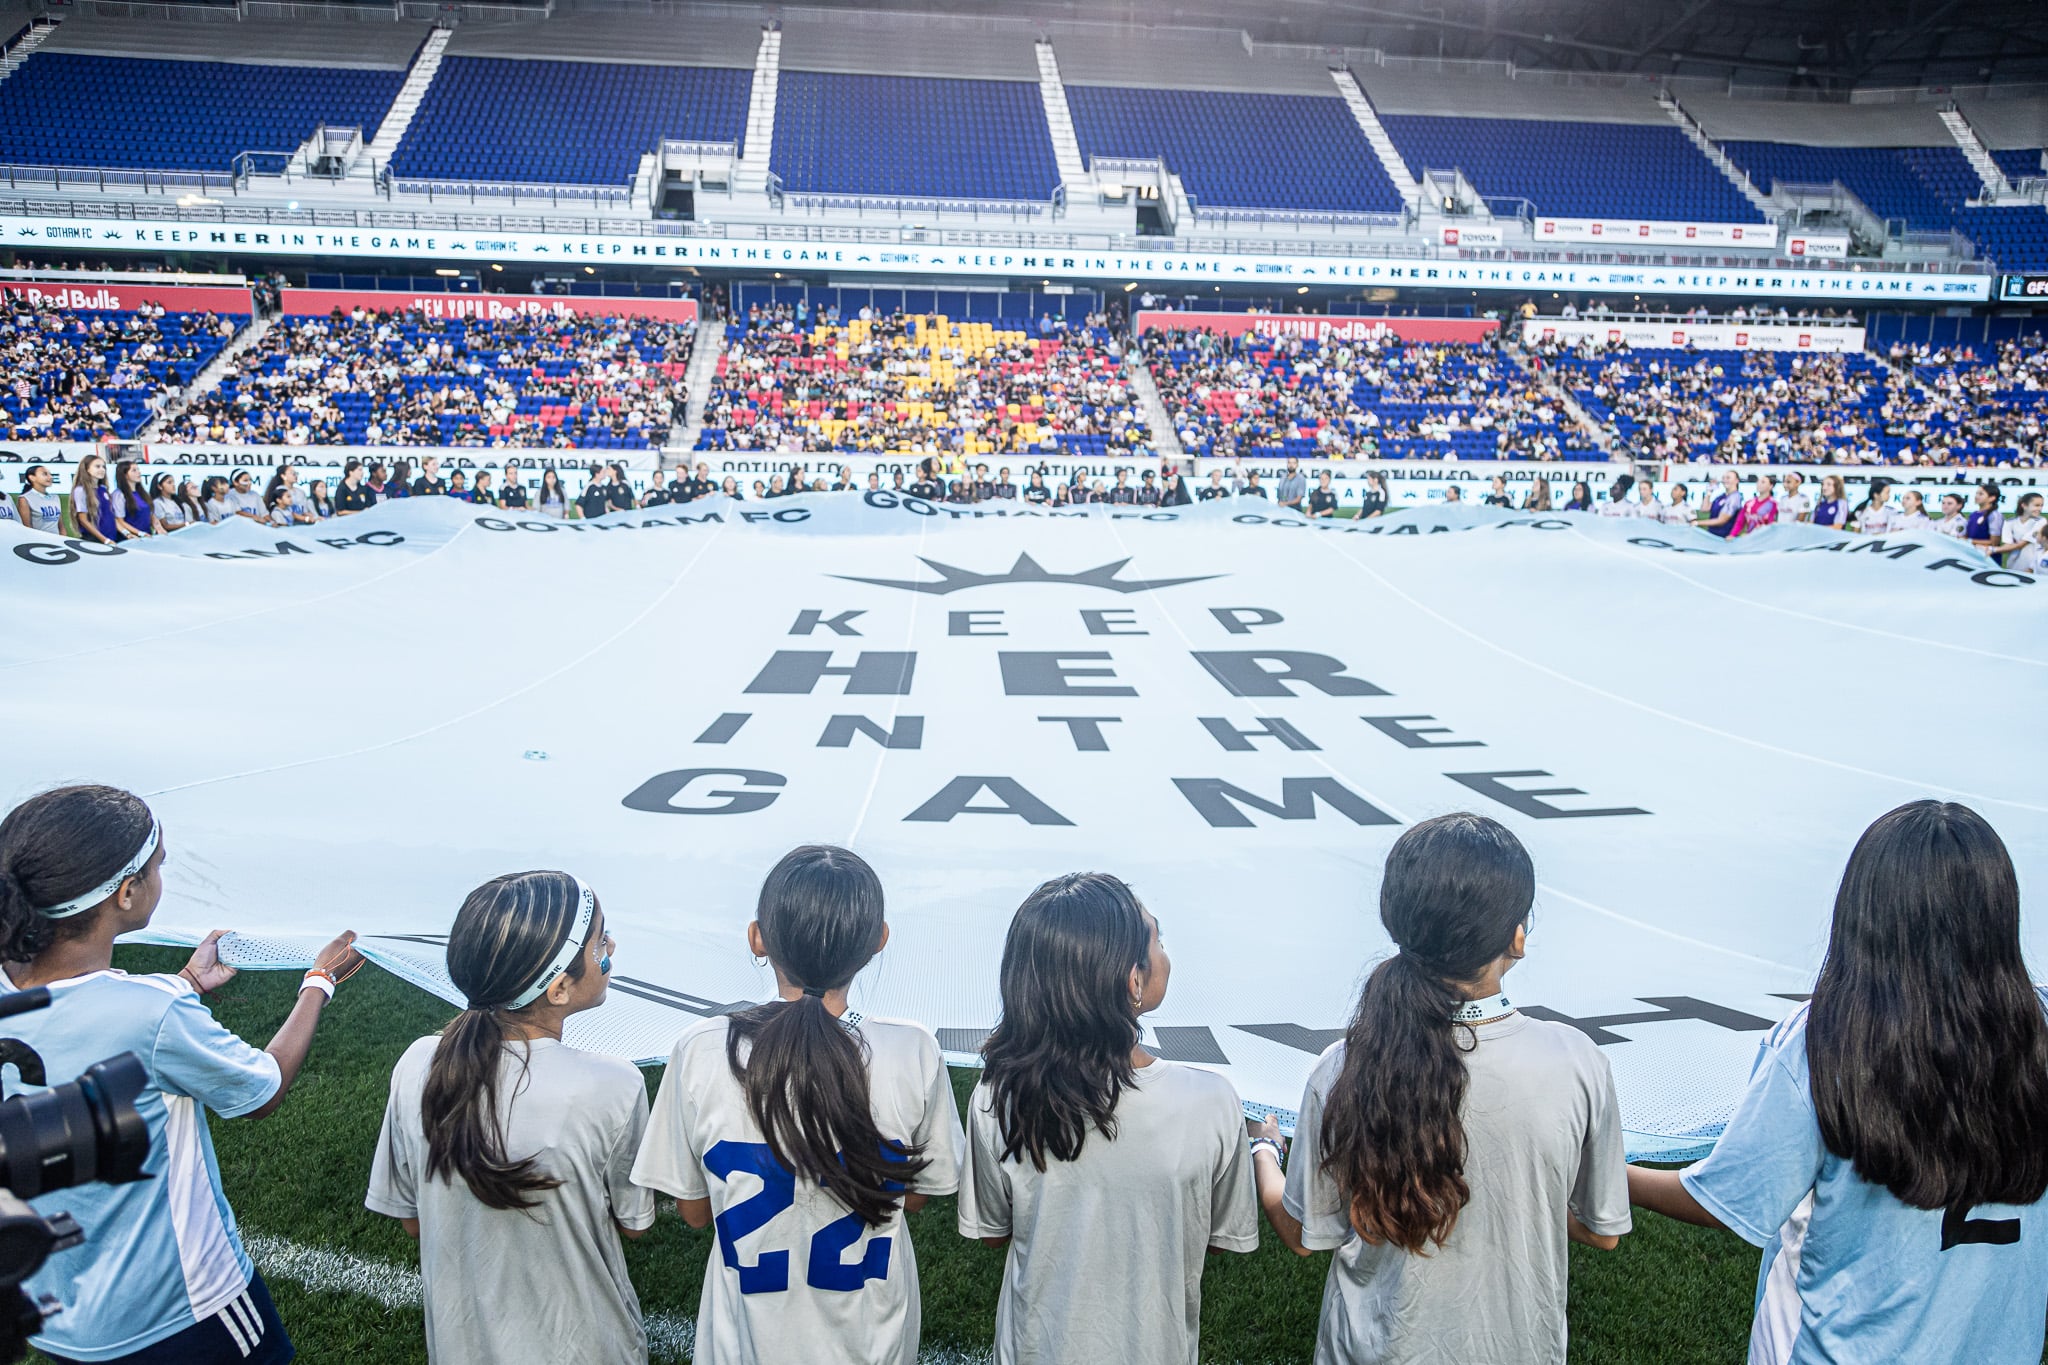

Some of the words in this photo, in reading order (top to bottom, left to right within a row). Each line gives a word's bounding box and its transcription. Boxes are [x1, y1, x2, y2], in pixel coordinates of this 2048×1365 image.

[46, 226, 80, 238] GOTHAM
[82, 228, 92, 239] FC
[136, 230, 198, 242] KEEP
[211, 232, 270, 244] HER
[281, 234, 304, 246] IN
[316, 235, 359, 248] THE
[371, 237, 437, 250] GAME
[1462, 234, 1497, 243] TOYOTA
[475, 240, 506, 251] GOTHAM
[508, 241, 518, 252] FC
[563, 243, 621, 255] KEEP
[633, 245, 689, 257] HER
[699, 247, 720, 258] IN
[731, 248, 772, 259] THE
[783, 250, 843, 262] GAME
[1808, 244, 1841, 253] TOYOTA
[958, 255, 1013, 266] KEEP
[1024, 257, 1075, 269] HER
[1085, 259, 1105, 269] IN
[1117, 260, 1153, 271] THE
[1164, 261, 1221, 272] GAME
[1329, 266, 1381, 277] KEEP
[1391, 268, 1439, 279] HER
[1448, 269, 1467, 280] IN
[1478, 270, 1513, 281] THE
[1522, 272, 1577, 283] GAME
[1679, 276, 1728, 287] KEEP
[1737, 277, 1782, 288] HER
[1791, 279, 1810, 289] IN
[1820, 280, 1853, 290] THE
[1862, 281, 1913, 292] GAME
[70, 289, 121, 310] Bulls
[864, 490, 1089, 519] GOTHAM
[474, 512, 725, 532] GOTHAM
[740, 508, 812, 523] FC
[13, 540, 312, 565] GOAM
[316, 530, 405, 549] FC
[1925, 558, 2037, 588] FC
[787, 607, 1285, 636] KEEP
[741, 650, 1397, 698] HER
[692, 712, 926, 750] IN
[1036, 714, 1489, 752] THE
[621, 768, 1654, 829] GAME
[704, 1139, 926, 1294] 22
